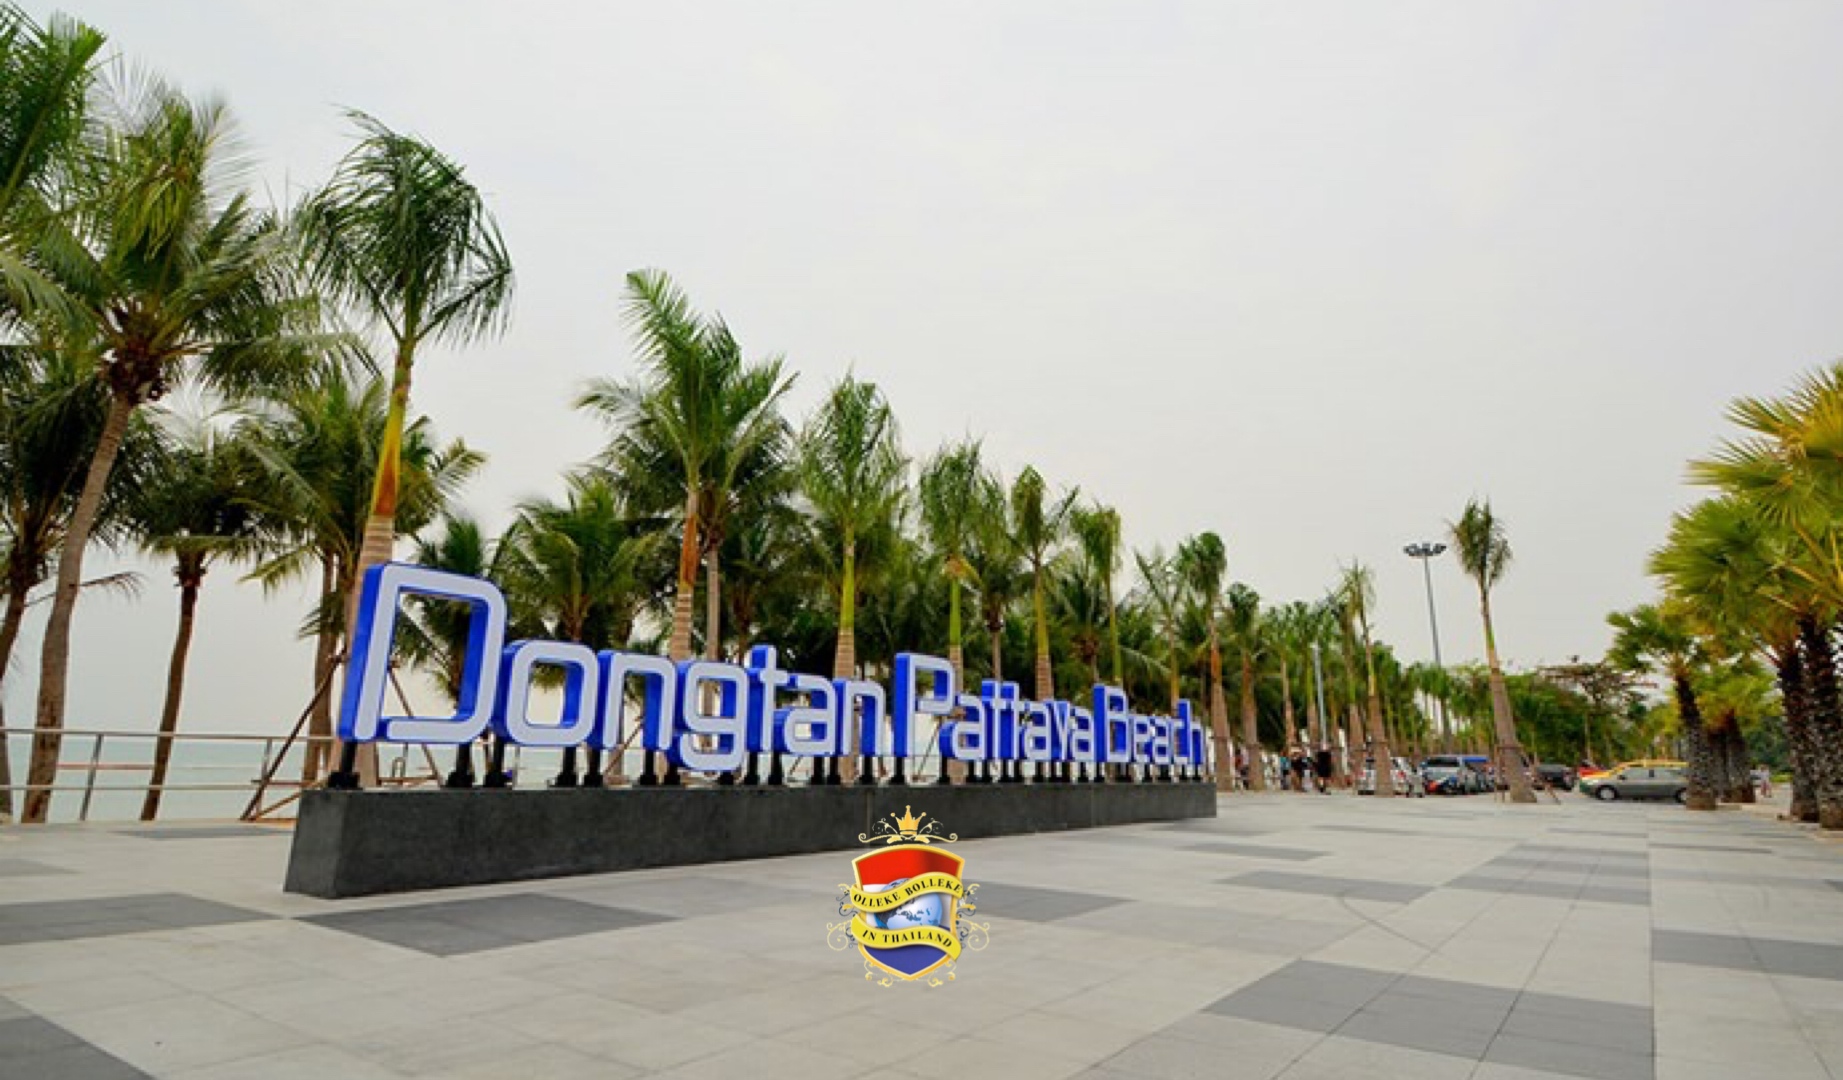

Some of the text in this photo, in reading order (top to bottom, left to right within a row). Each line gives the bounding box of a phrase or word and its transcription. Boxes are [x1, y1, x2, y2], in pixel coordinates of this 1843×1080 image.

[342, 562, 1206, 772] Dongtan Pattaya Beach
